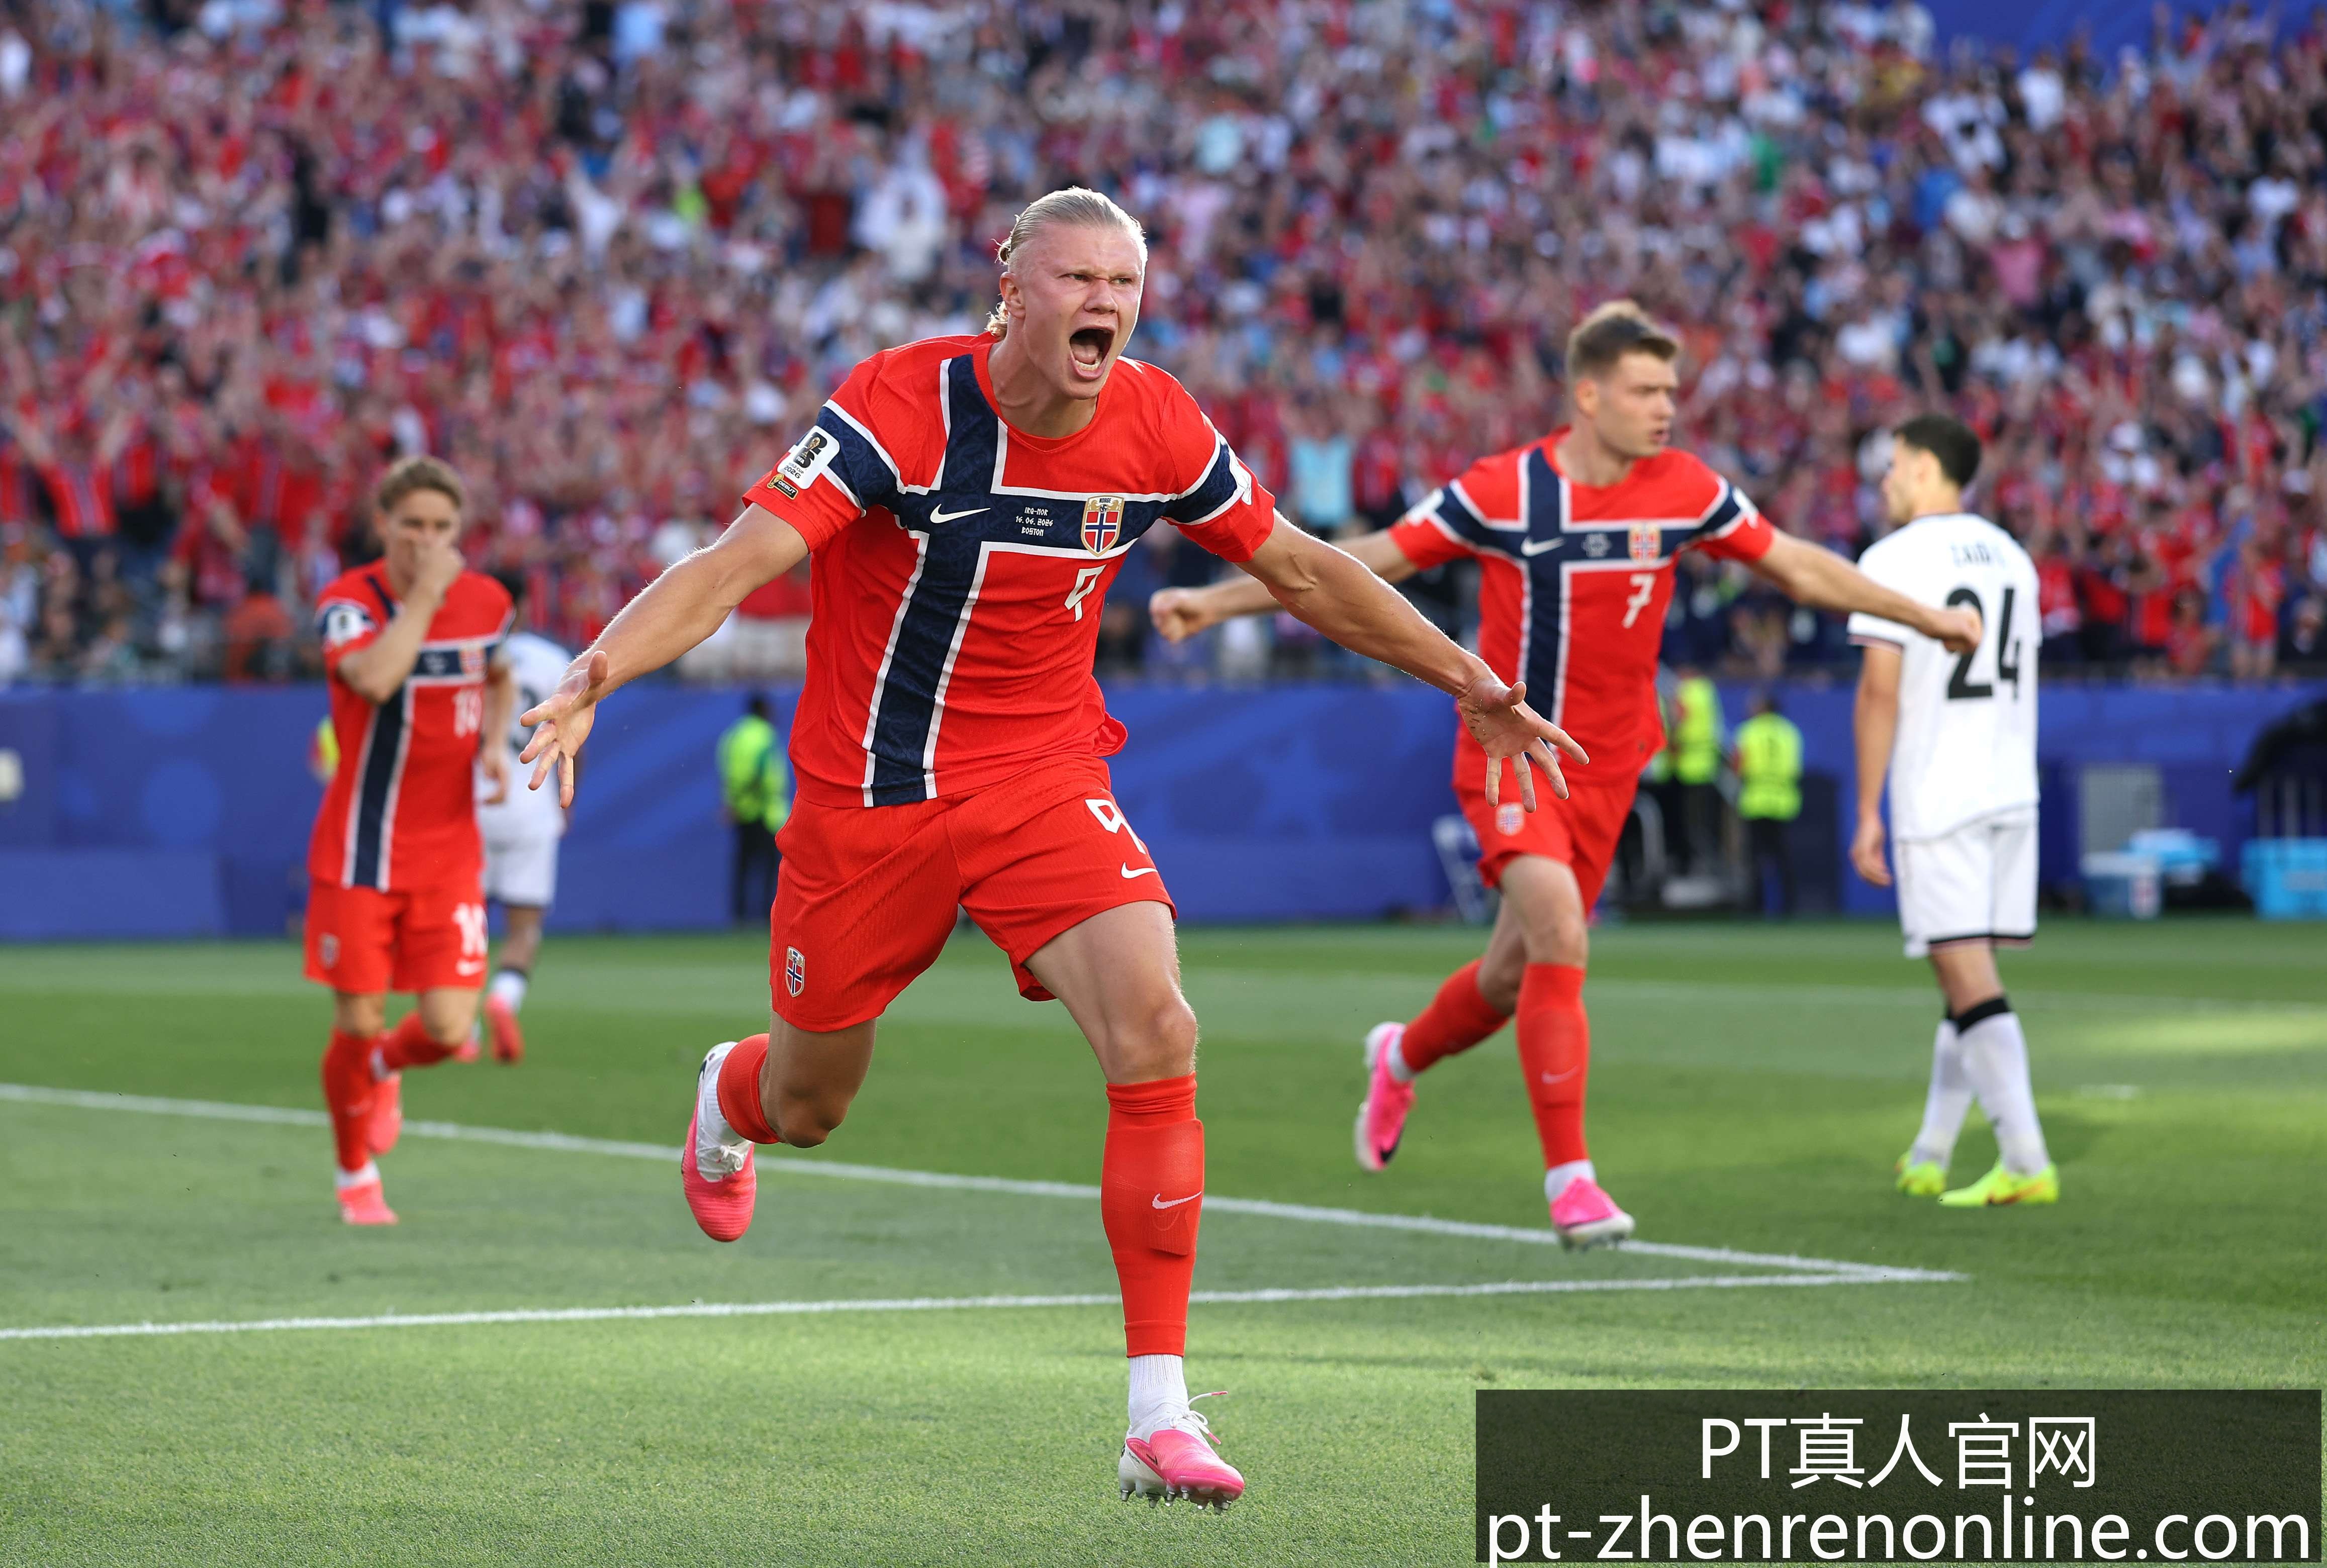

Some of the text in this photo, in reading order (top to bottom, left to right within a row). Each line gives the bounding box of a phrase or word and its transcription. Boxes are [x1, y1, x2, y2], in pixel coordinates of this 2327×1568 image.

[778, 481, 796, 494] DEBUT
[784, 465, 801, 478] 2026
[1025, 507, 1049, 516] IRQ-NOR
[1021, 526, 1044, 536] BOSTON
[1064, 564, 1106, 622] 9
[1622, 573, 1656, 629] 7
[1945, 585, 2020, 702] 24
[1085, 799, 1147, 855] 9
